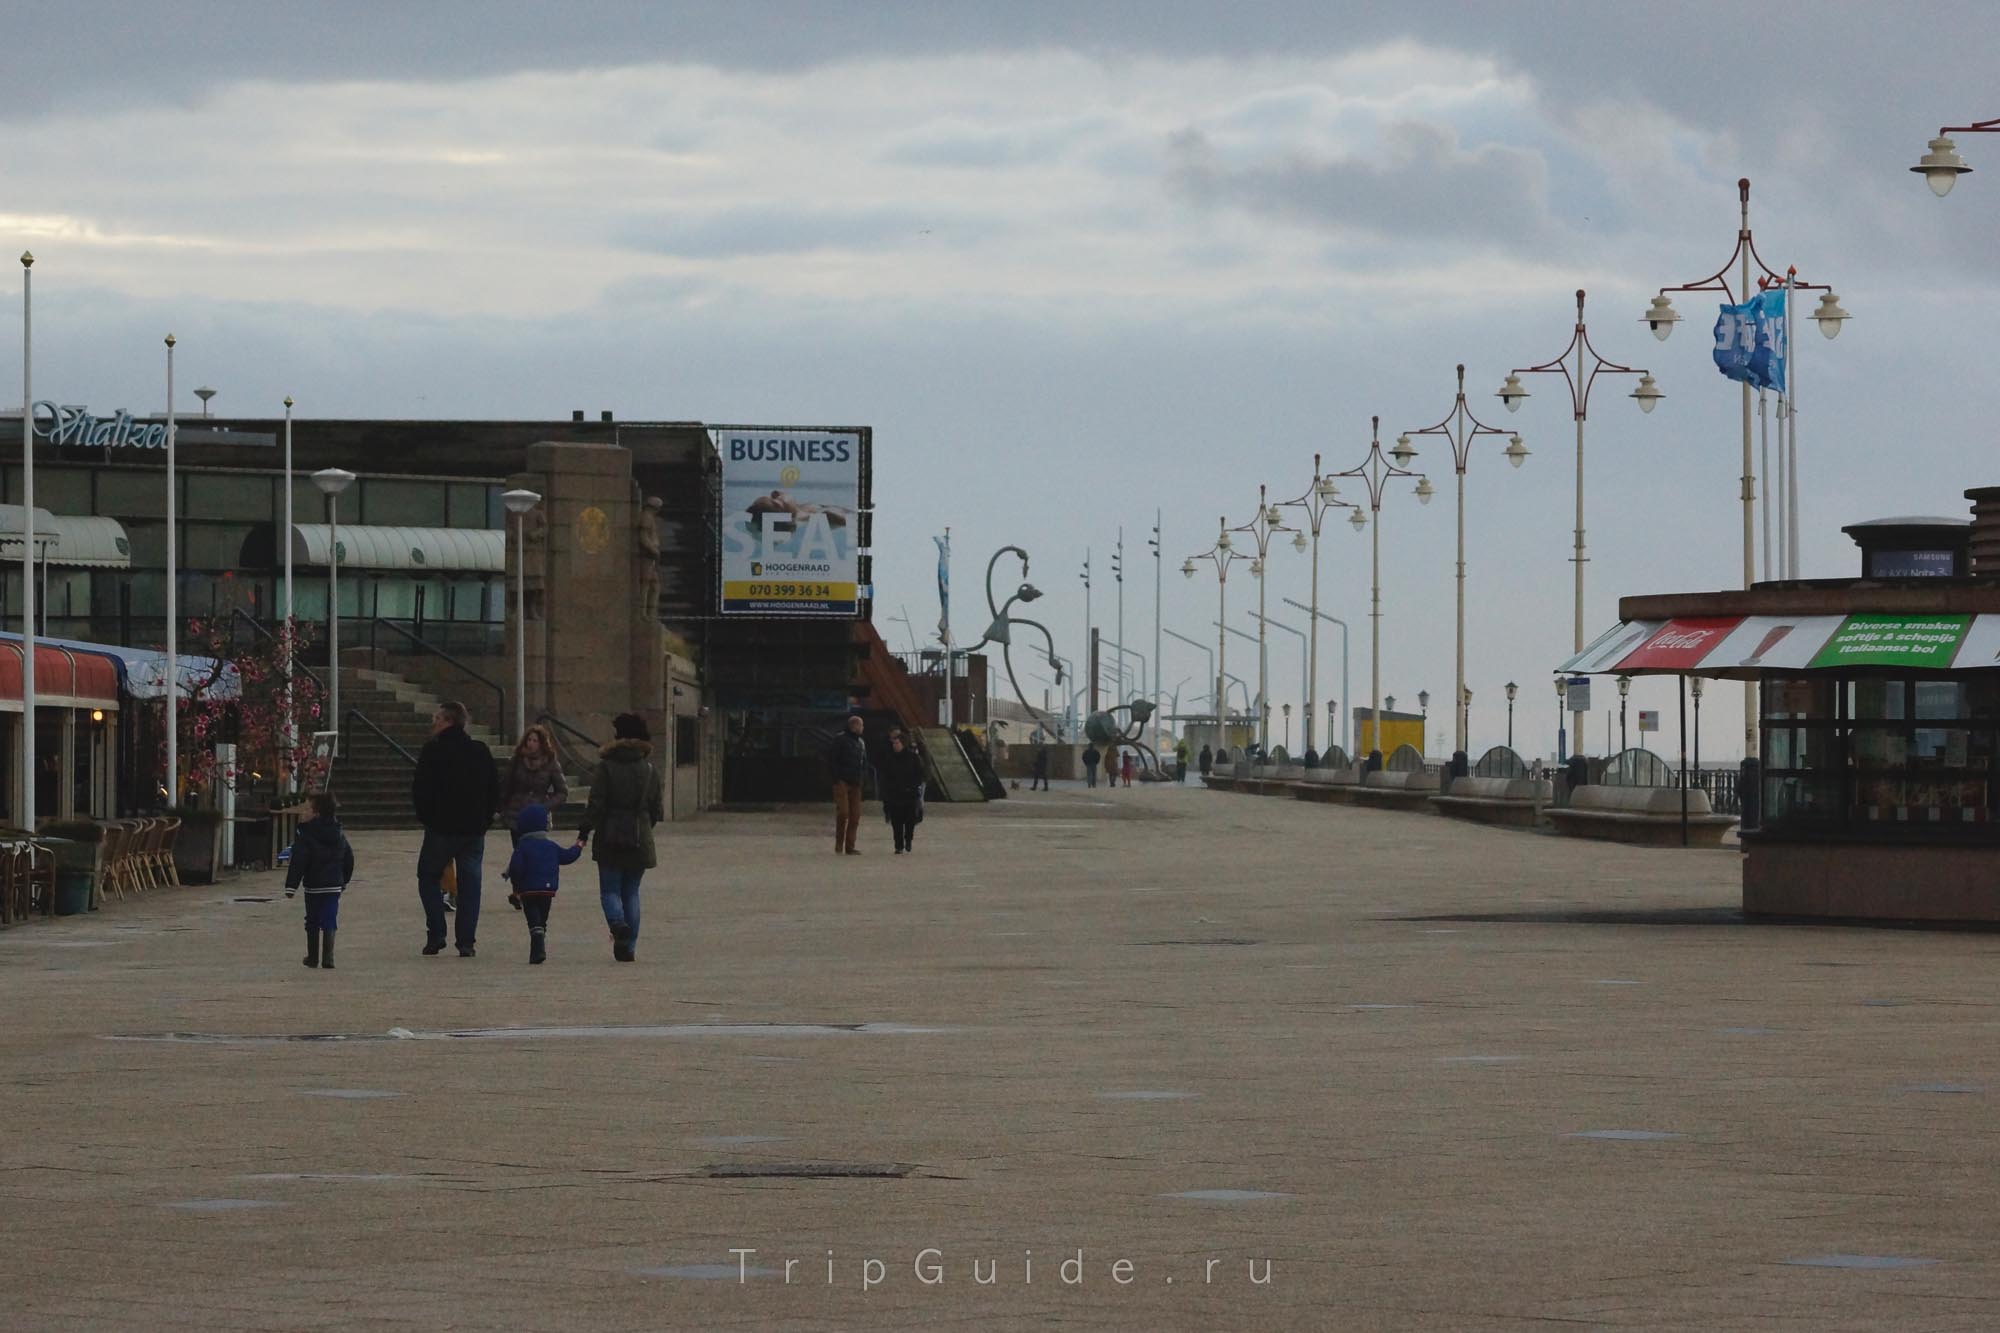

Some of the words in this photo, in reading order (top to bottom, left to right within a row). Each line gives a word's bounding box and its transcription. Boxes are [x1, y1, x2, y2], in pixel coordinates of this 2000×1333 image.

[731, 439, 850, 462] BUSINESS
[1913, 553, 1950, 561] SAMSUNG
[766, 563, 830, 572] HOOGENRAAD
[1910, 568, 1936, 577] Note
[750, 584, 771, 595] 070
[774, 584, 795, 596] 399
[799, 585, 813, 596] 36
[816, 585, 830, 596] 34
[1847, 622, 1902, 631] Diverse
[1904, 622, 1961, 631] smaken
[1883, 633, 1894, 641] &
[1896, 633, 1957, 643] schepijs
[1911, 644, 1938, 654] bol
